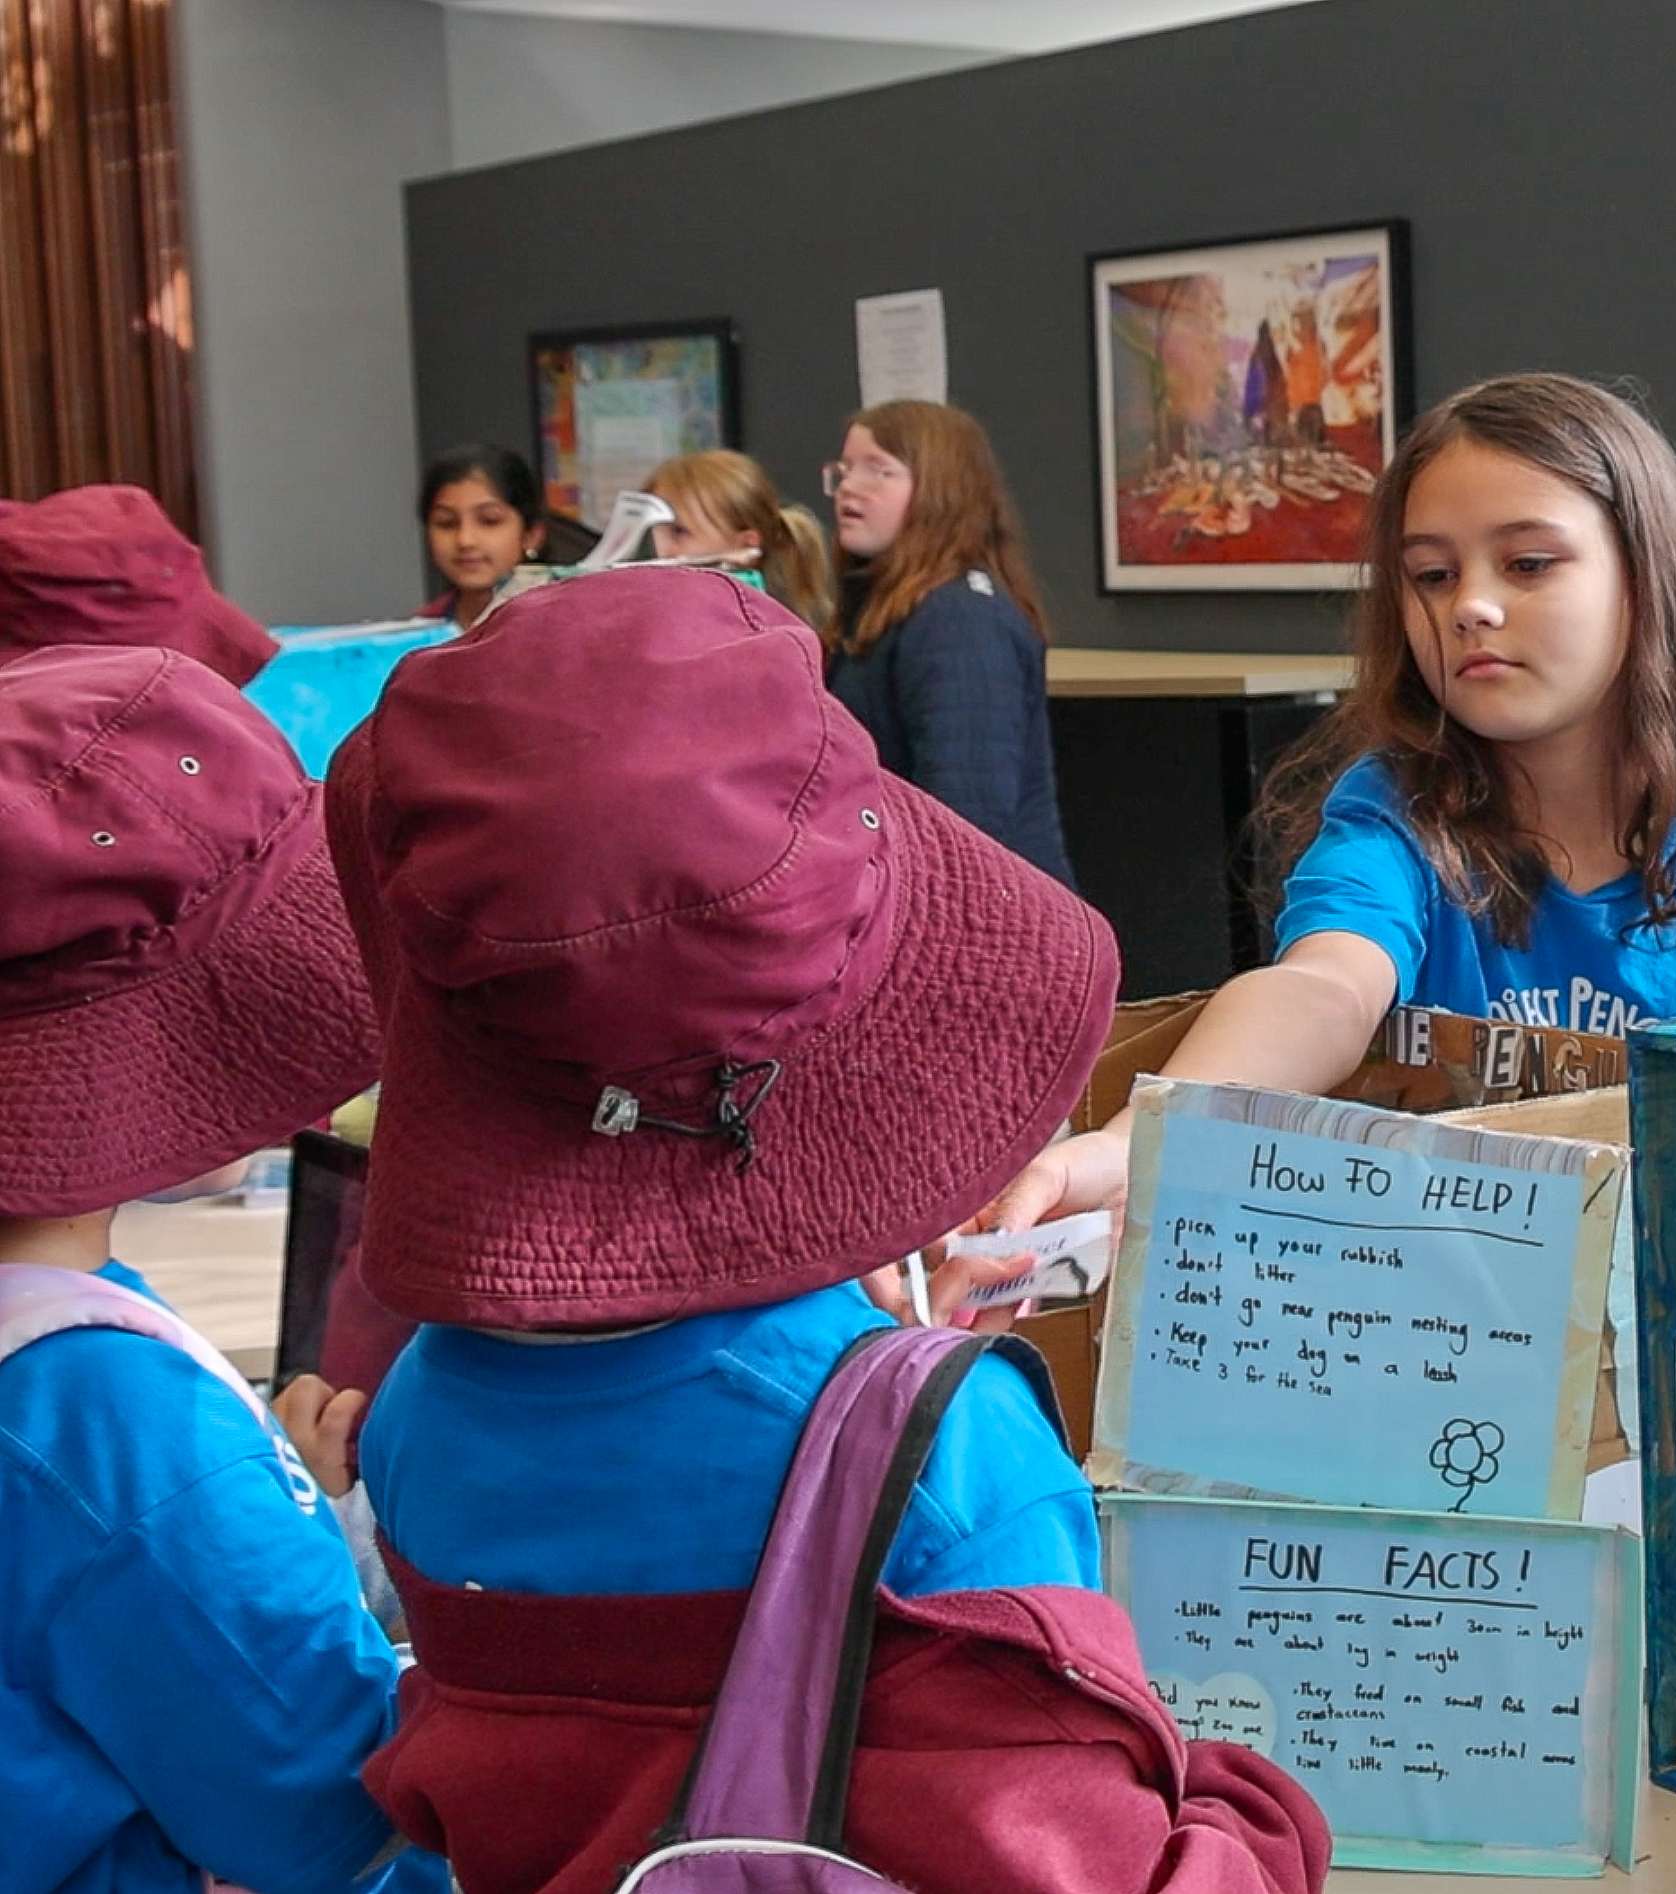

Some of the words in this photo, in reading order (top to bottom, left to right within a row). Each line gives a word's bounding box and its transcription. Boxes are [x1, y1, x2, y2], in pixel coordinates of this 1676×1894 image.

[1345, 1156, 1393, 1197] TO
[1421, 1174, 1539, 1231] HELP!
[1175, 1248, 1223, 1272] don't
[1255, 1262, 1296, 1283] litter
[1235, 1231, 1259, 1256] up
[1278, 1240, 1323, 1257] your
[1340, 1246, 1403, 1269] rubbish
[1174, 1280, 1223, 1306] don't
[1238, 1297, 1262, 1328] go
[1281, 1302, 1315, 1319] near
[1328, 1310, 1392, 1339] penguin
[1410, 1316, 1468, 1355] nesting
[1487, 1329, 1534, 1346] areas
[1217, 1362, 1229, 1380] 3
[1245, 1364, 1267, 1384] for
[1277, 1371, 1298, 1389] the
[1308, 1380, 1332, 1396] sea
[1233, 1338, 1270, 1357] your
[1297, 1338, 1328, 1378] dog
[1344, 1352, 1361, 1365] on
[1383, 1364, 1399, 1376] a
[1423, 1359, 1458, 1384] leash
[1244, 1538, 1323, 1583] FUN
[1383, 1545, 1531, 1593] FACTS!
[1247, 1609, 1313, 1636] penguins
[1335, 1613, 1366, 1625] are
[1391, 1611, 1443, 1628] about
[1516, 1624, 1531, 1637] in
[1185, 1630, 1211, 1652] They
[1284, 1634, 1324, 1651] about
[1385, 1647, 1397, 1659] in
[1414, 1646, 1459, 1674] weight
[1301, 1681, 1333, 1702] They
[1403, 1694, 1422, 1704] on
[1444, 1694, 1483, 1711] small
[1502, 1695, 1526, 1713] fish
[1551, 1695, 1580, 1715] and
[1302, 1728, 1338, 1752] They
[1416, 1742, 1434, 1751] on
[1464, 1740, 1527, 1759] coastal
